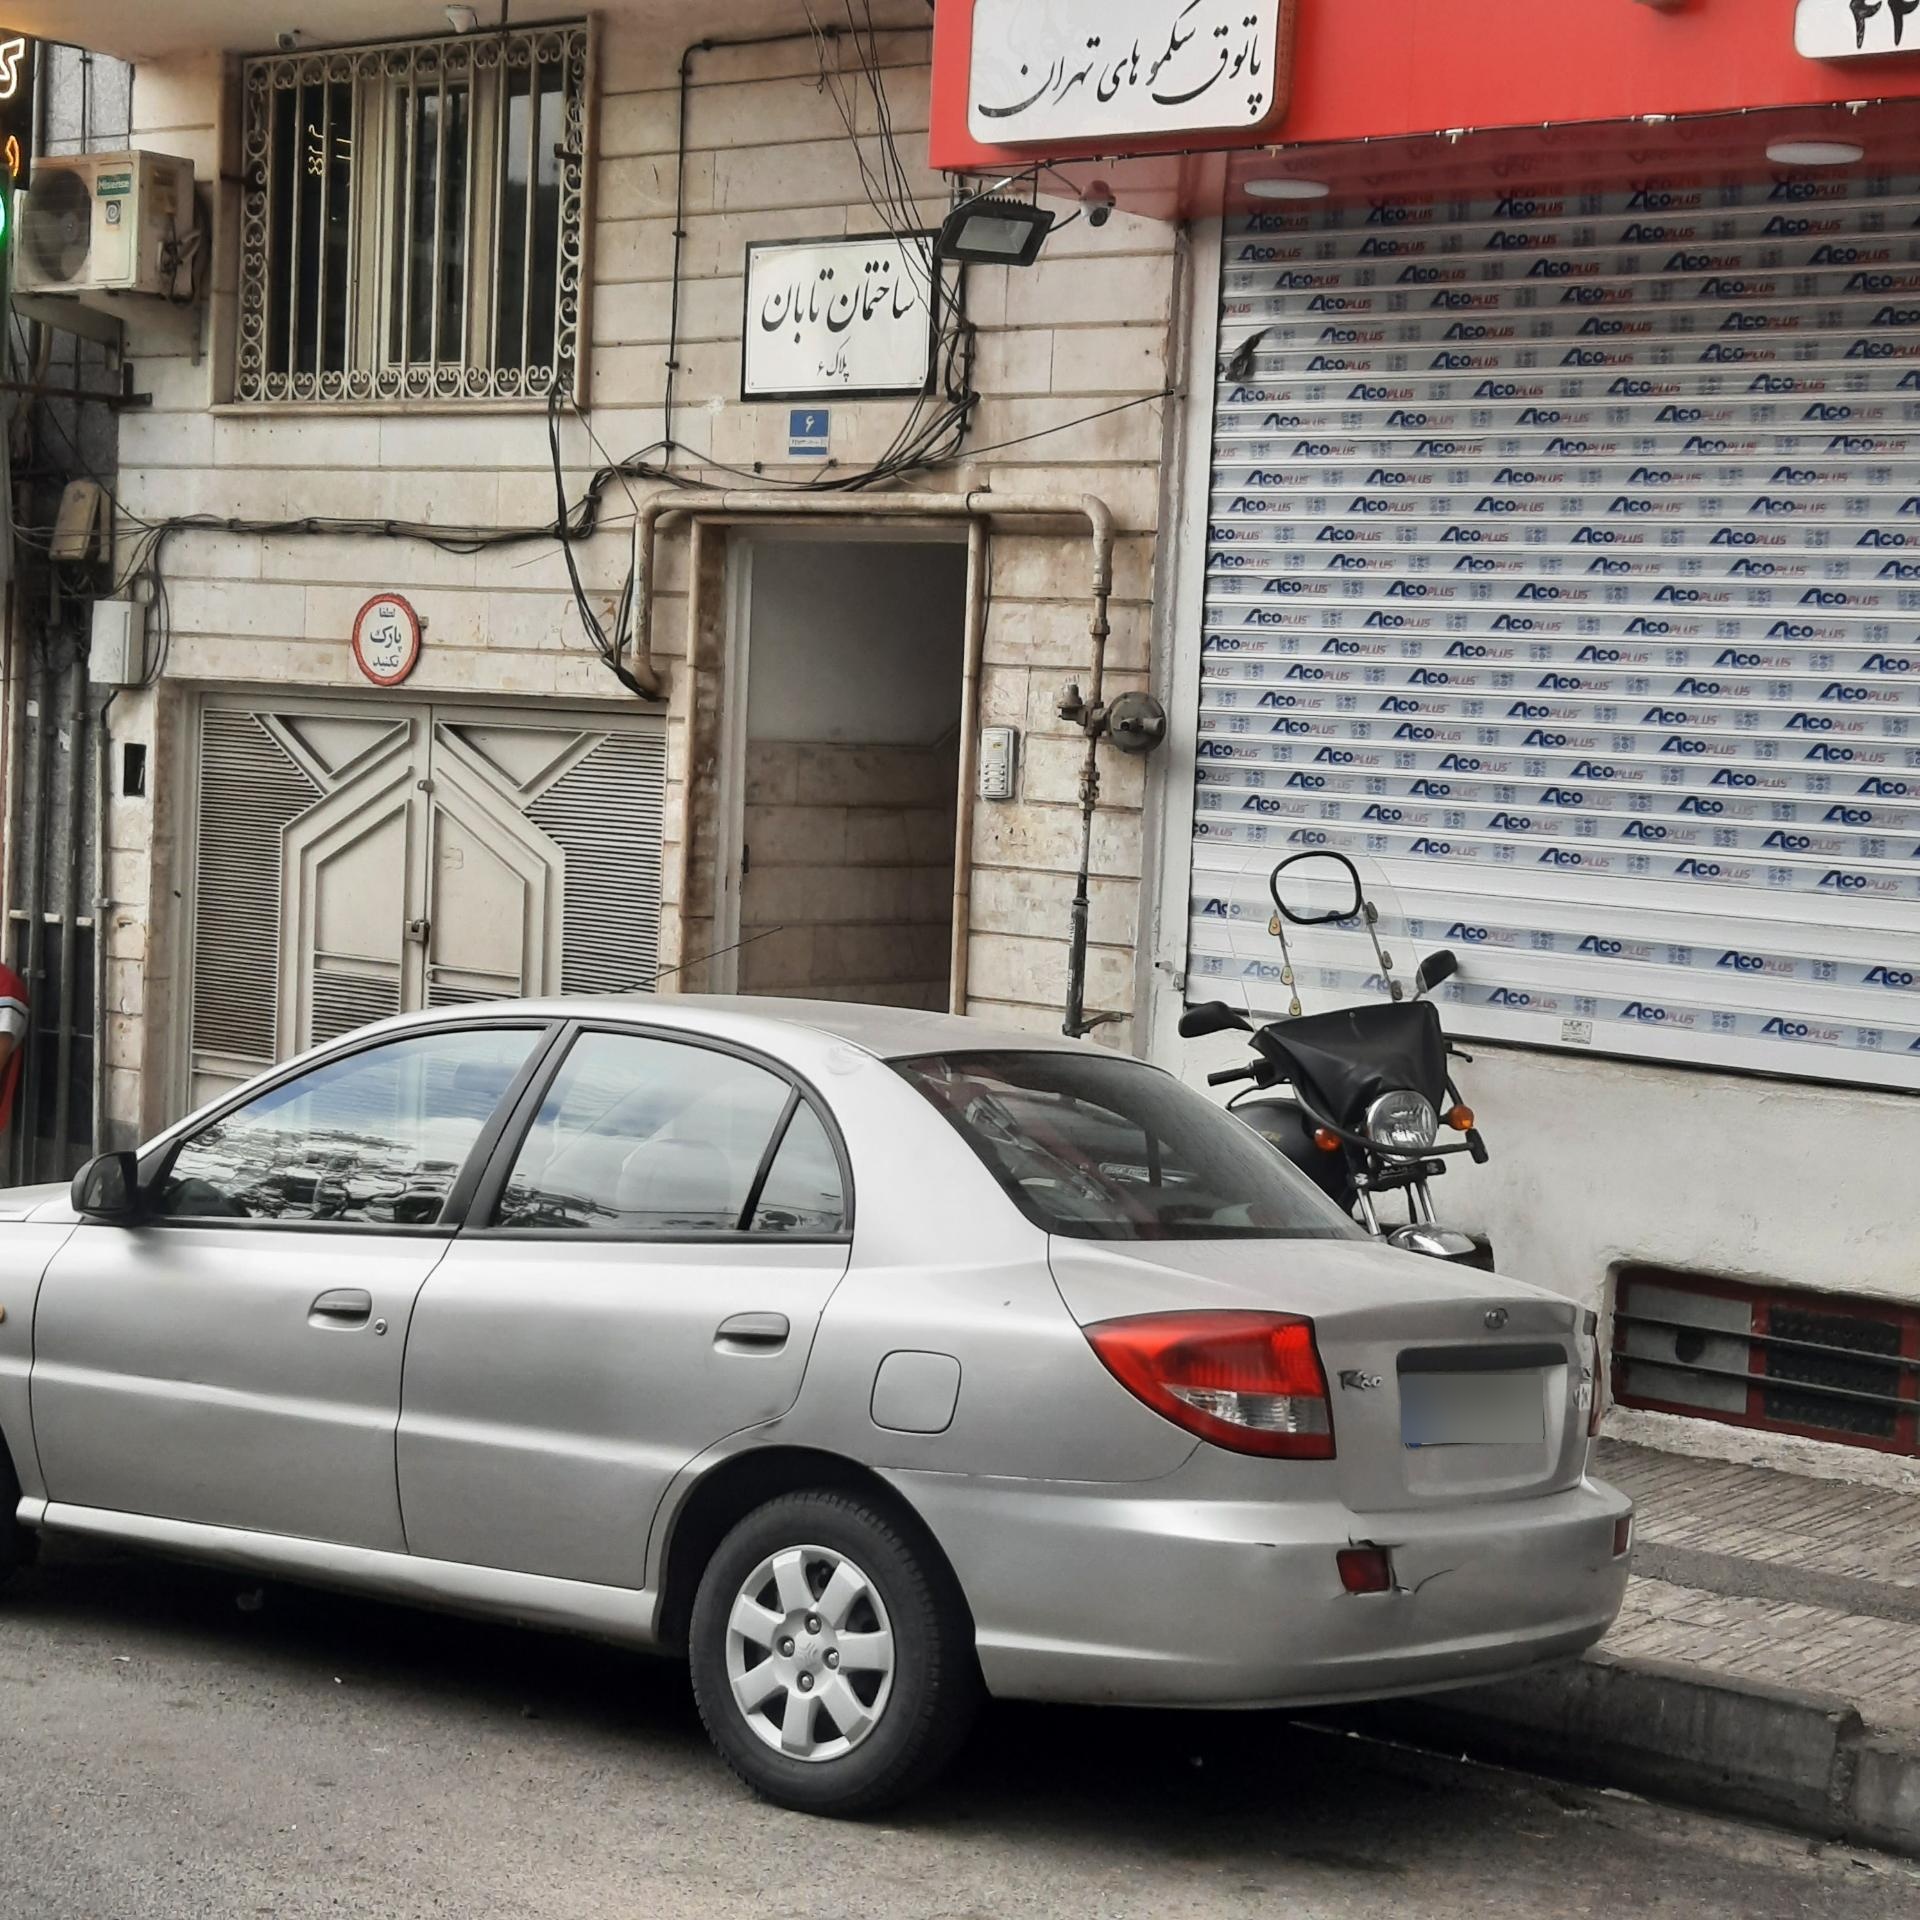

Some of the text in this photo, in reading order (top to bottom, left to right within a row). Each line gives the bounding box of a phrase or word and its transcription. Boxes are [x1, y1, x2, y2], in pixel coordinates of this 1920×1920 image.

[978, 36, 1100, 118] تهران
[1152, 15, 1263, 116] پاتوق
[761, 260, 915, 344] ساختمان تابان
[826, 336, 851, 383] پلاک
[805, 415, 815, 433] ۶
[370, 625, 403, 653] پارک
[373, 655, 400, 671] نکنید
